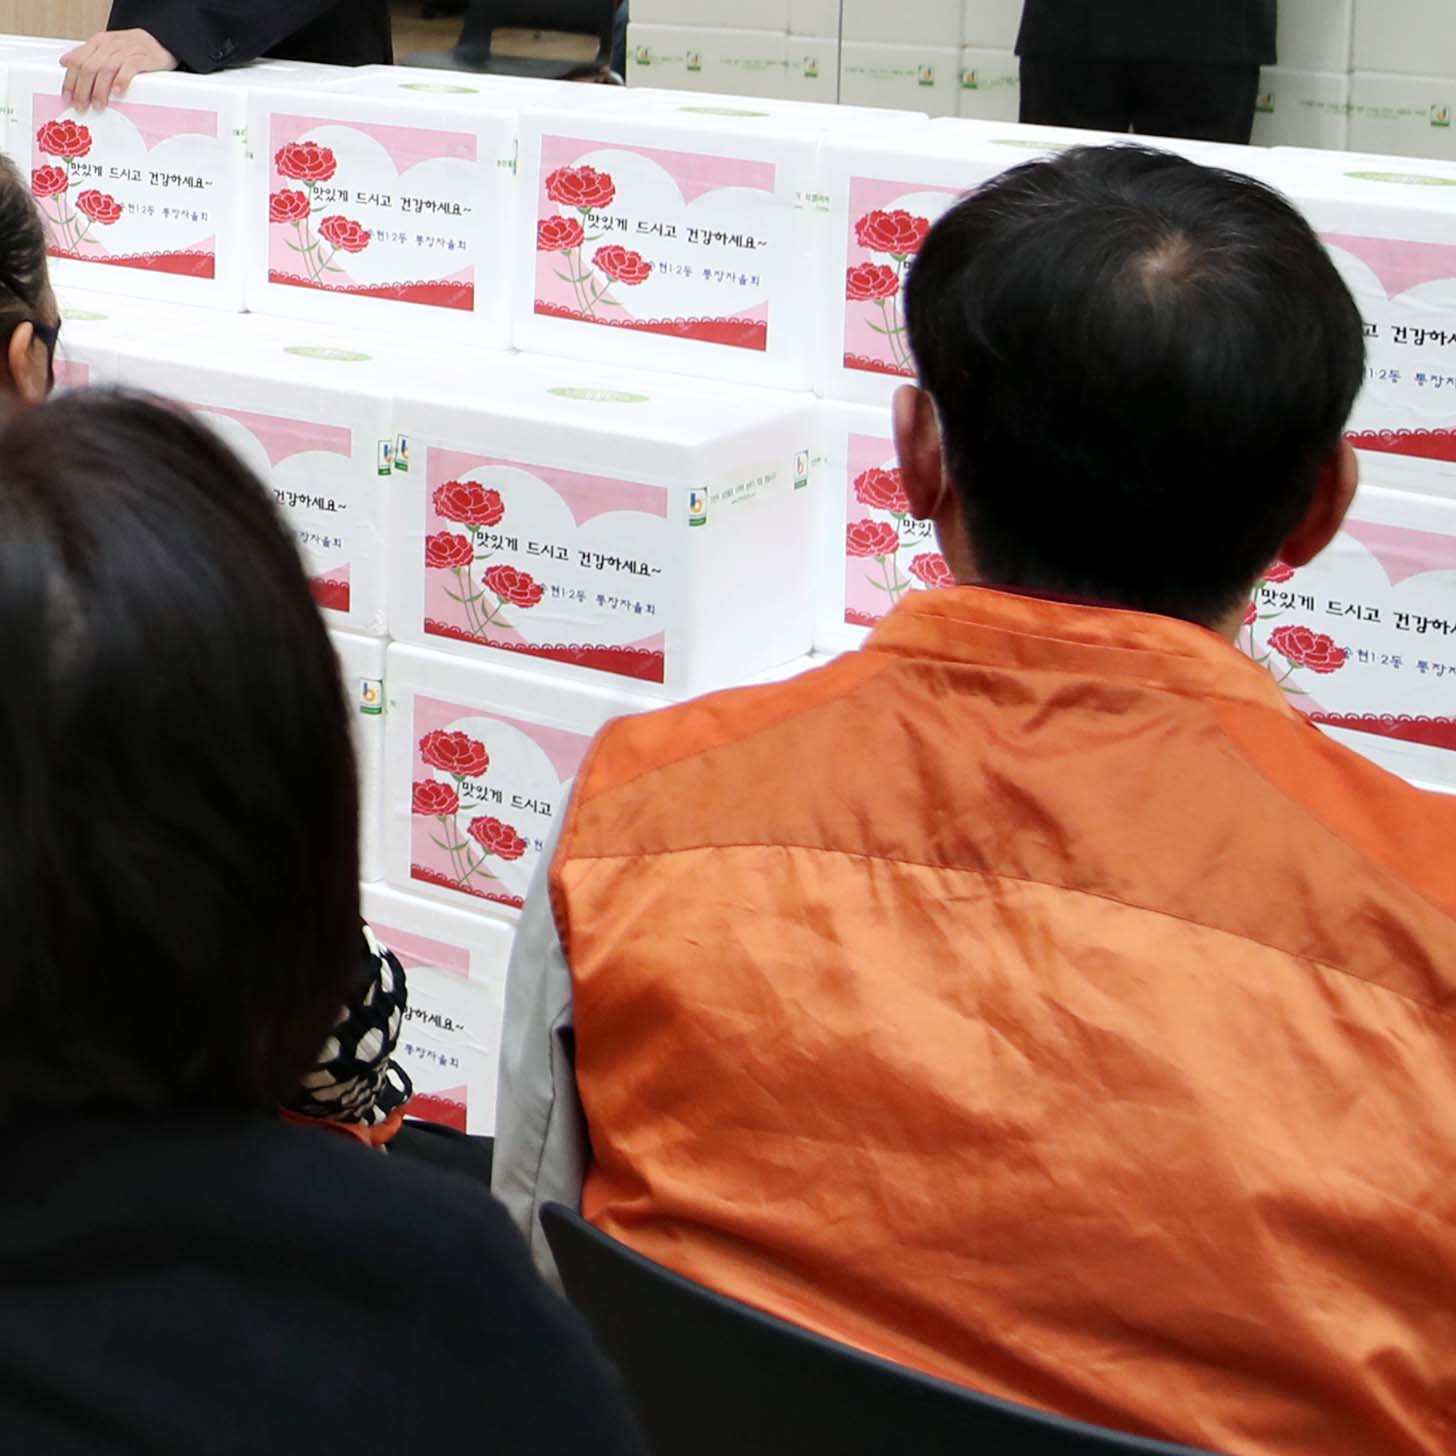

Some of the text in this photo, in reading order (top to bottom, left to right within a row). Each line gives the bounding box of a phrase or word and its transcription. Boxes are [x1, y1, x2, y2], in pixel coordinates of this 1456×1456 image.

[71, 163, 102, 177] 맛있게
[109, 167, 142, 181] 드시고
[313, 187, 348, 202] 맛있게
[356, 192, 392, 207] 드시고
[587, 214, 628, 231] 맛있게
[636, 221, 677, 238] 드시고
[300, 531, 342, 548] 장자율회
[902, 519, 932, 538] 맛있
[476, 531, 662, 577] 맛있게 드시고 건강하세요~
[1261, 588, 1315, 611] 맛있게
[1325, 600, 1381, 624] 드시고
[461, 781, 553, 817] 맛있게 드시고
[402, 1006, 465, 1032] 강하세요~
